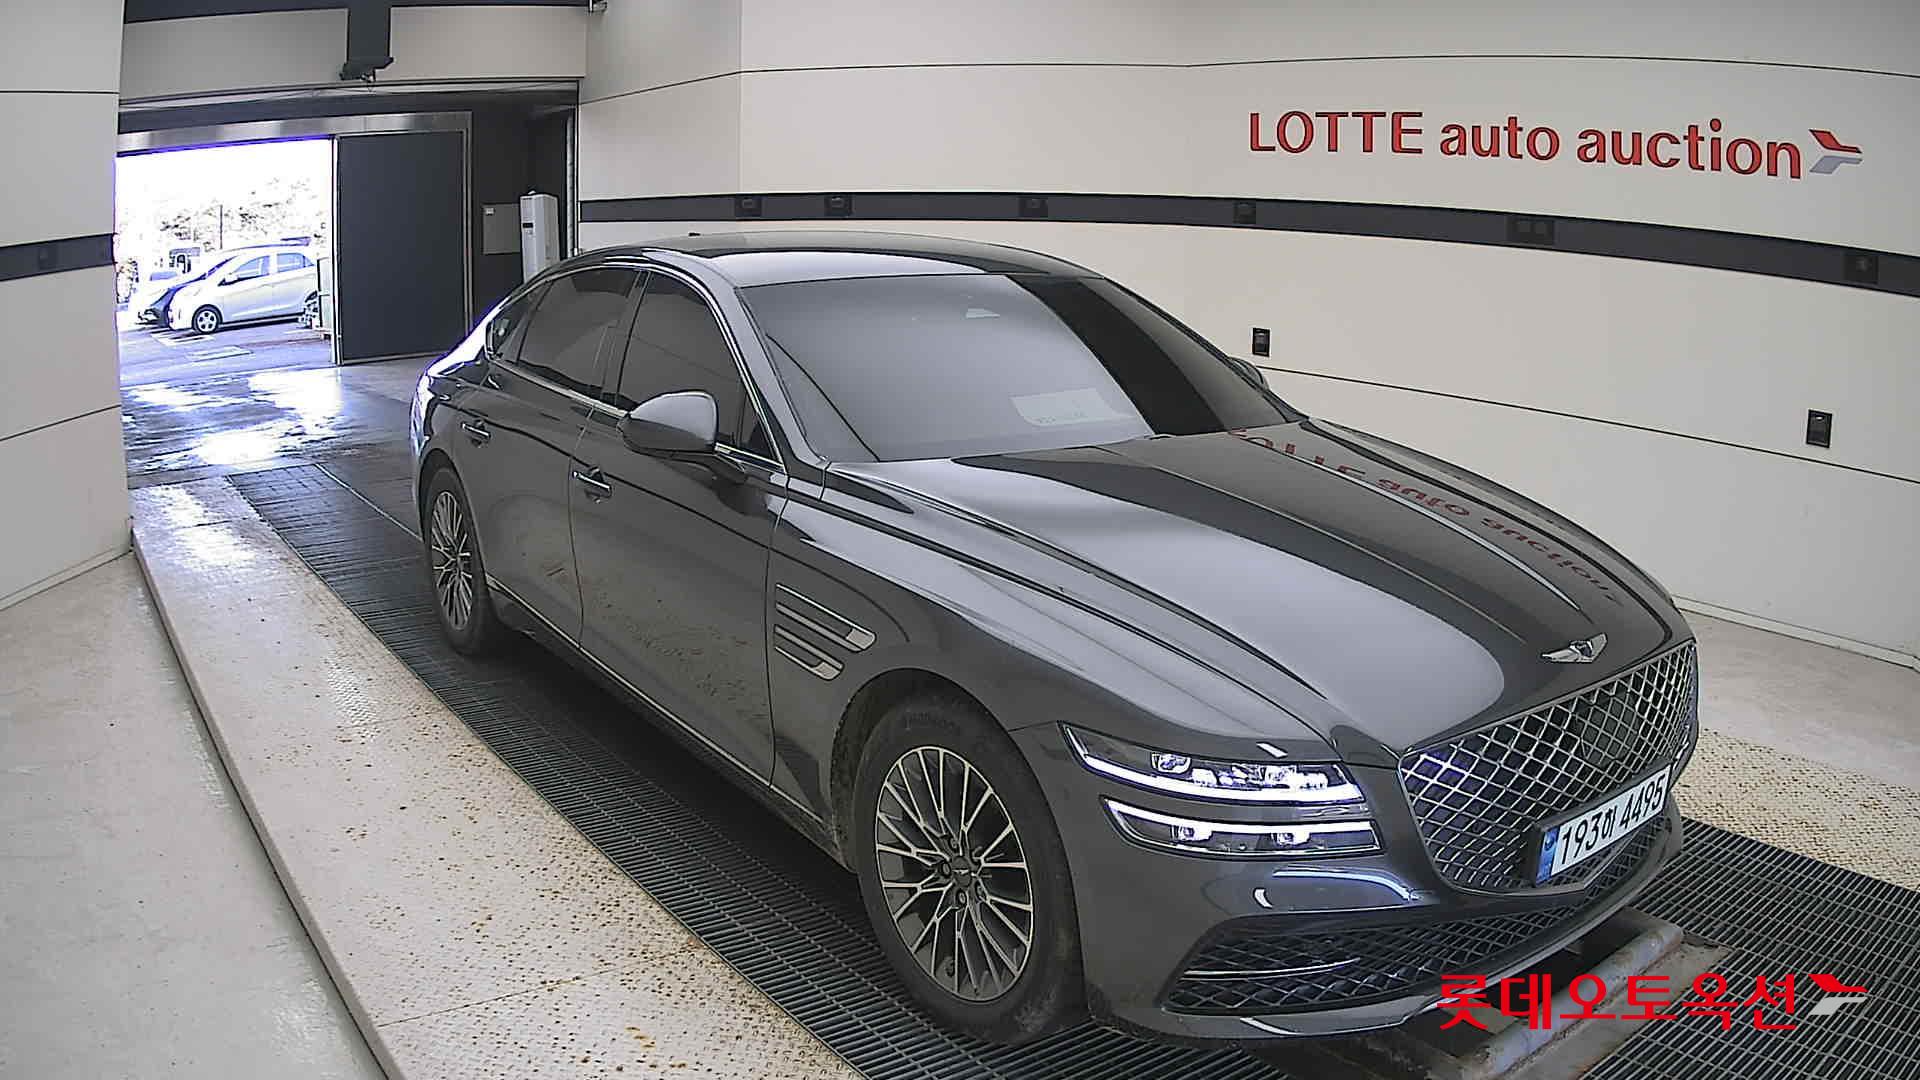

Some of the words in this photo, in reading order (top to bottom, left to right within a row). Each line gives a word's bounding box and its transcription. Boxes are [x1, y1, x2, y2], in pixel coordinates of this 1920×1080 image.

[1249, 111, 1424, 155] LOTTE
[1440, 116, 1561, 161] auto
[1577, 118, 1803, 179] auction
[1619, 773, 1666, 829] 4495
